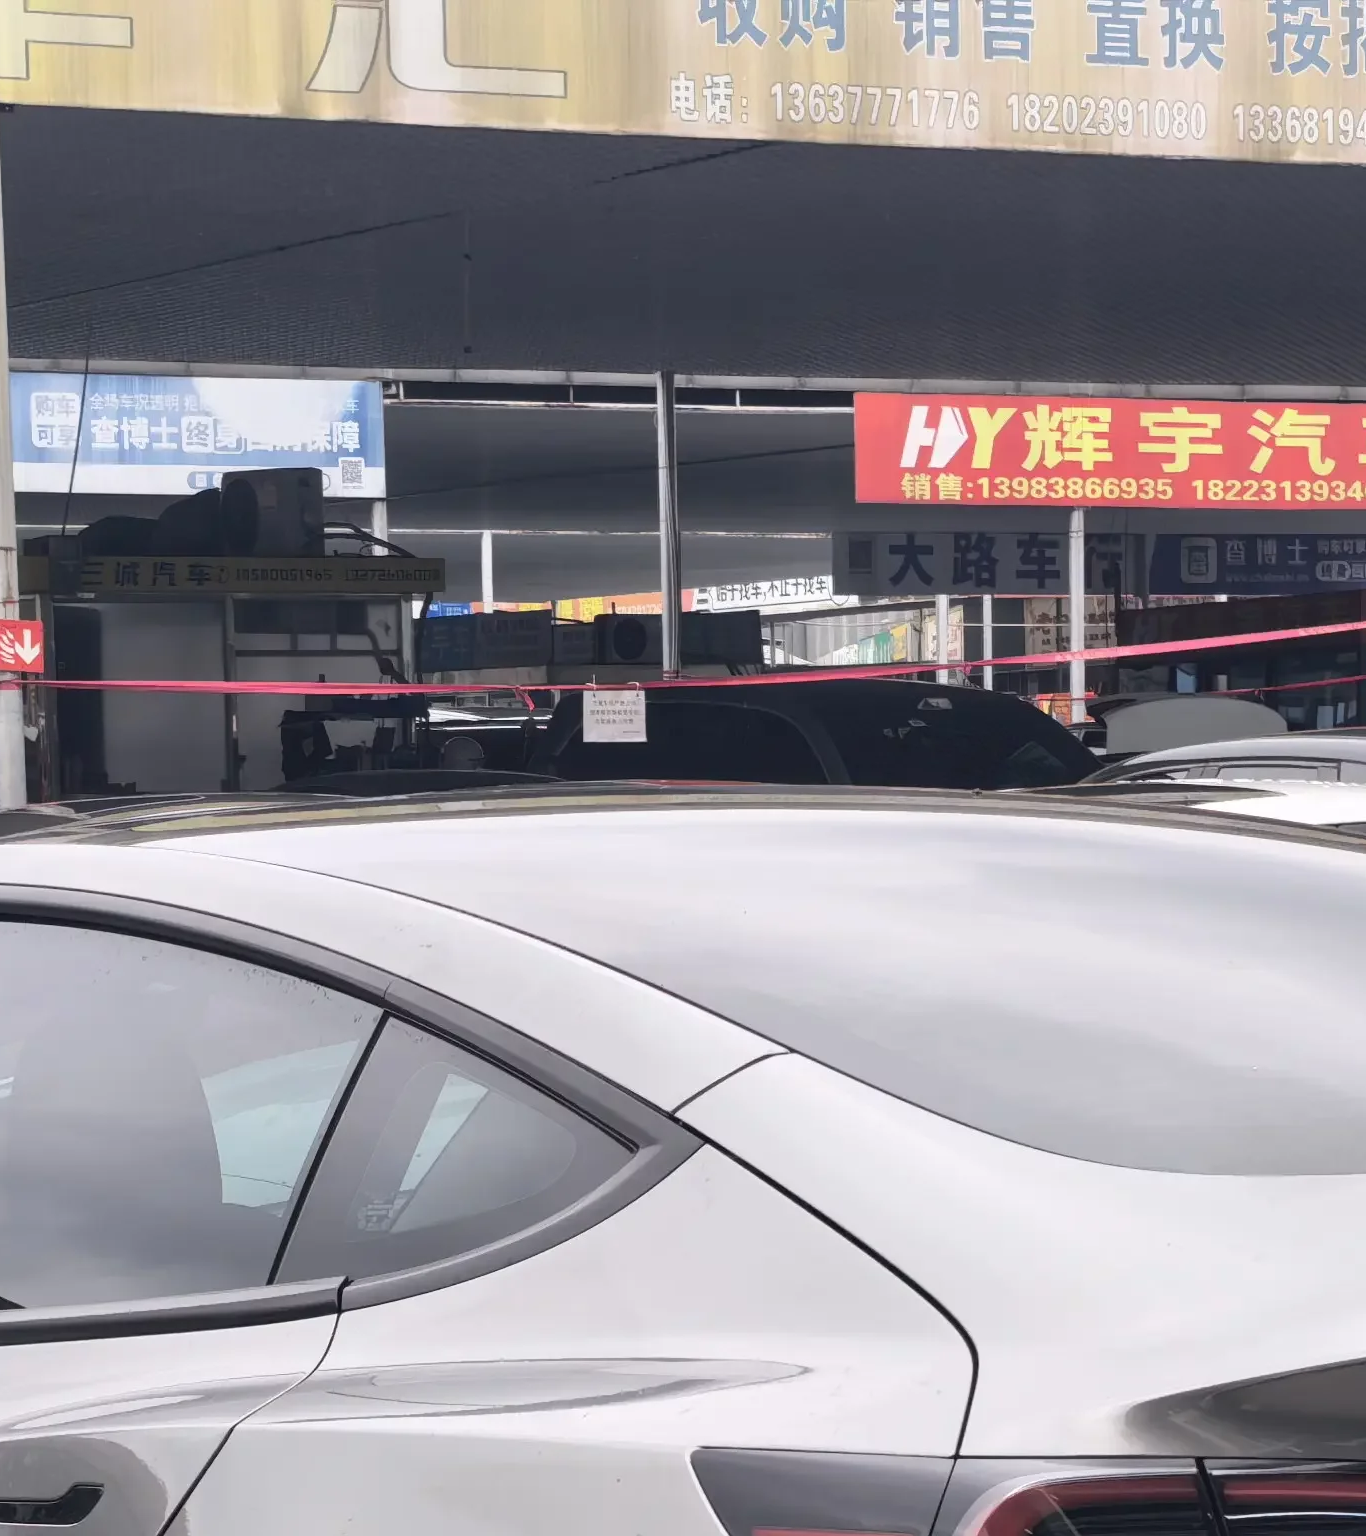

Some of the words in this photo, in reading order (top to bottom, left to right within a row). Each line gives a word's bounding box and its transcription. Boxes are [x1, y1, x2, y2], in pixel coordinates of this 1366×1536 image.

[697, 0, 846, 53] 收购
[894, 0, 1035, 63] 销售
[1084, 0, 1226, 70] 置换
[770, 82, 980, 131] 13637771776
[1006, 92, 1207, 141] 18202391080
